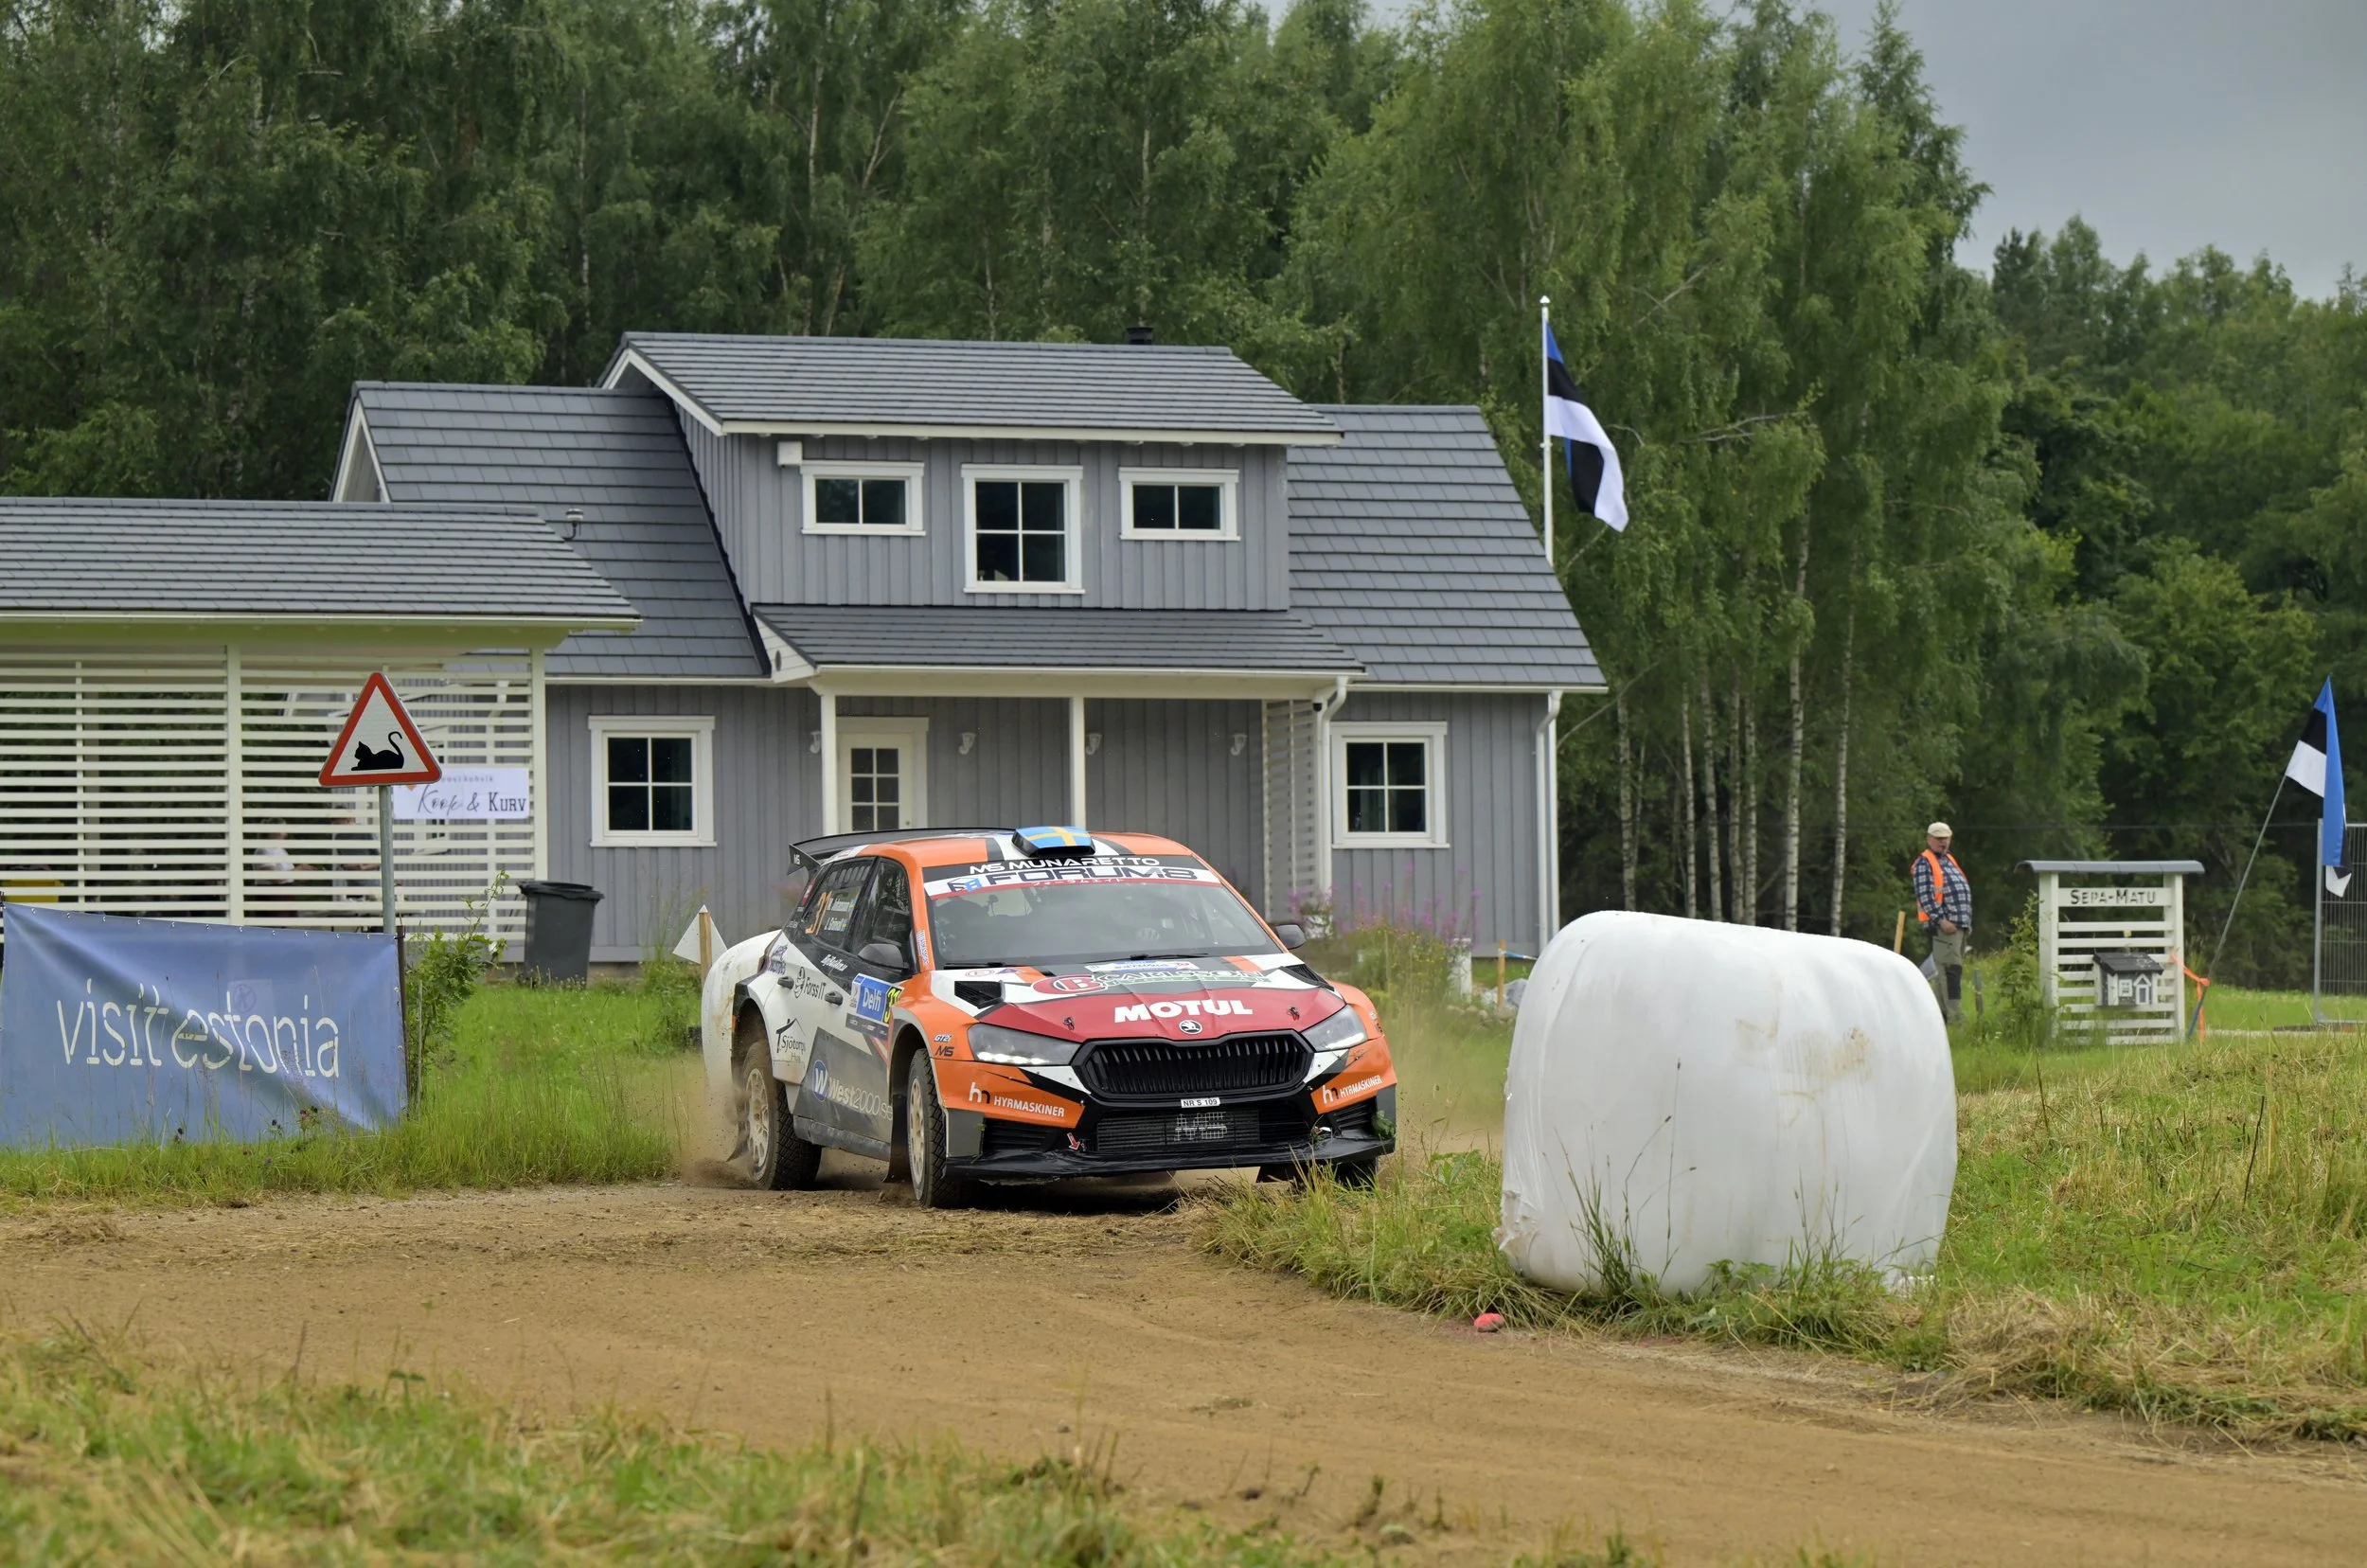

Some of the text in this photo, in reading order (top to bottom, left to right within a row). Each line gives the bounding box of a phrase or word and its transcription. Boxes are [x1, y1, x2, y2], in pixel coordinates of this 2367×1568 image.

[467, 792, 480, 812] &
[489, 792, 526, 812] KURV
[970, 857, 1160, 875] MS MUNARETTO
[986, 866, 1198, 885] FORUM8
[862, 987, 881, 1012] Delfi
[1114, 1000, 1254, 1024] MOTUL
[57, 978, 339, 1078] visit estonia
[934, 1045, 954, 1057] MS
[1340, 1075, 1382, 1098] HYRMASKINER
[994, 1096, 1065, 1117] HYRMASKINER
